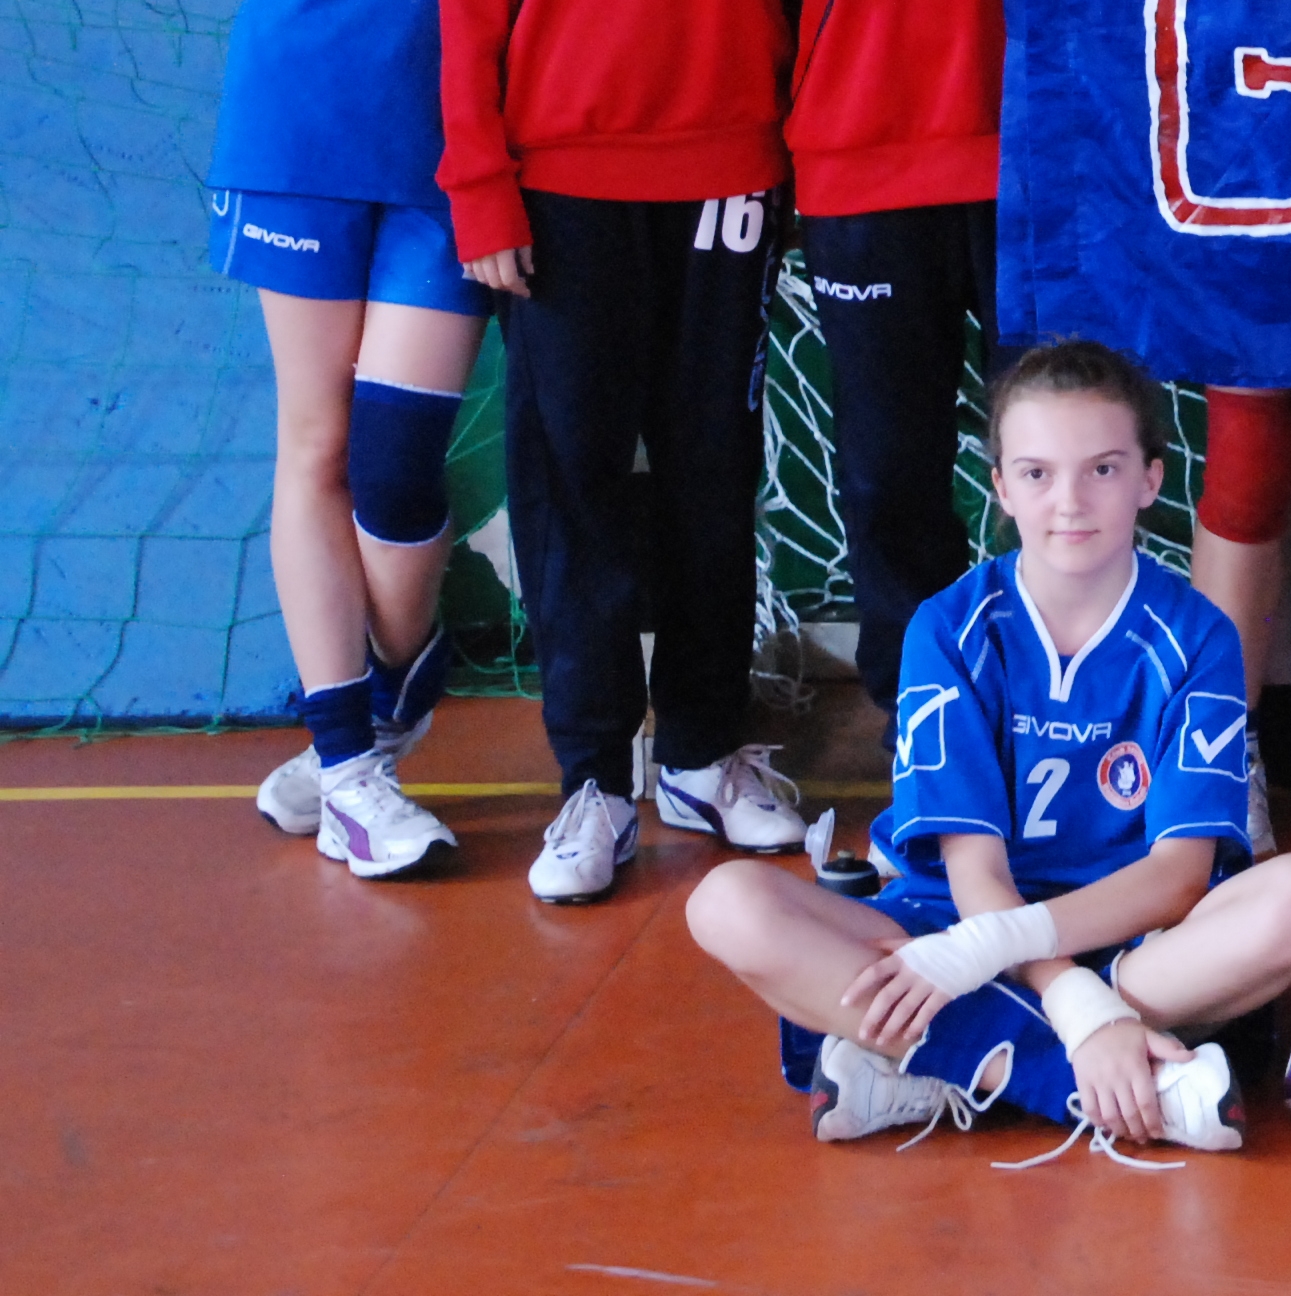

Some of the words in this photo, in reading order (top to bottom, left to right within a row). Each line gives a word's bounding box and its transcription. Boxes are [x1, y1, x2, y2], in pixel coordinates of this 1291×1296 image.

[242, 222, 321, 254] GIVOVA
[693, 191, 766, 254] 16
[1022, 756, 1071, 839] 2
